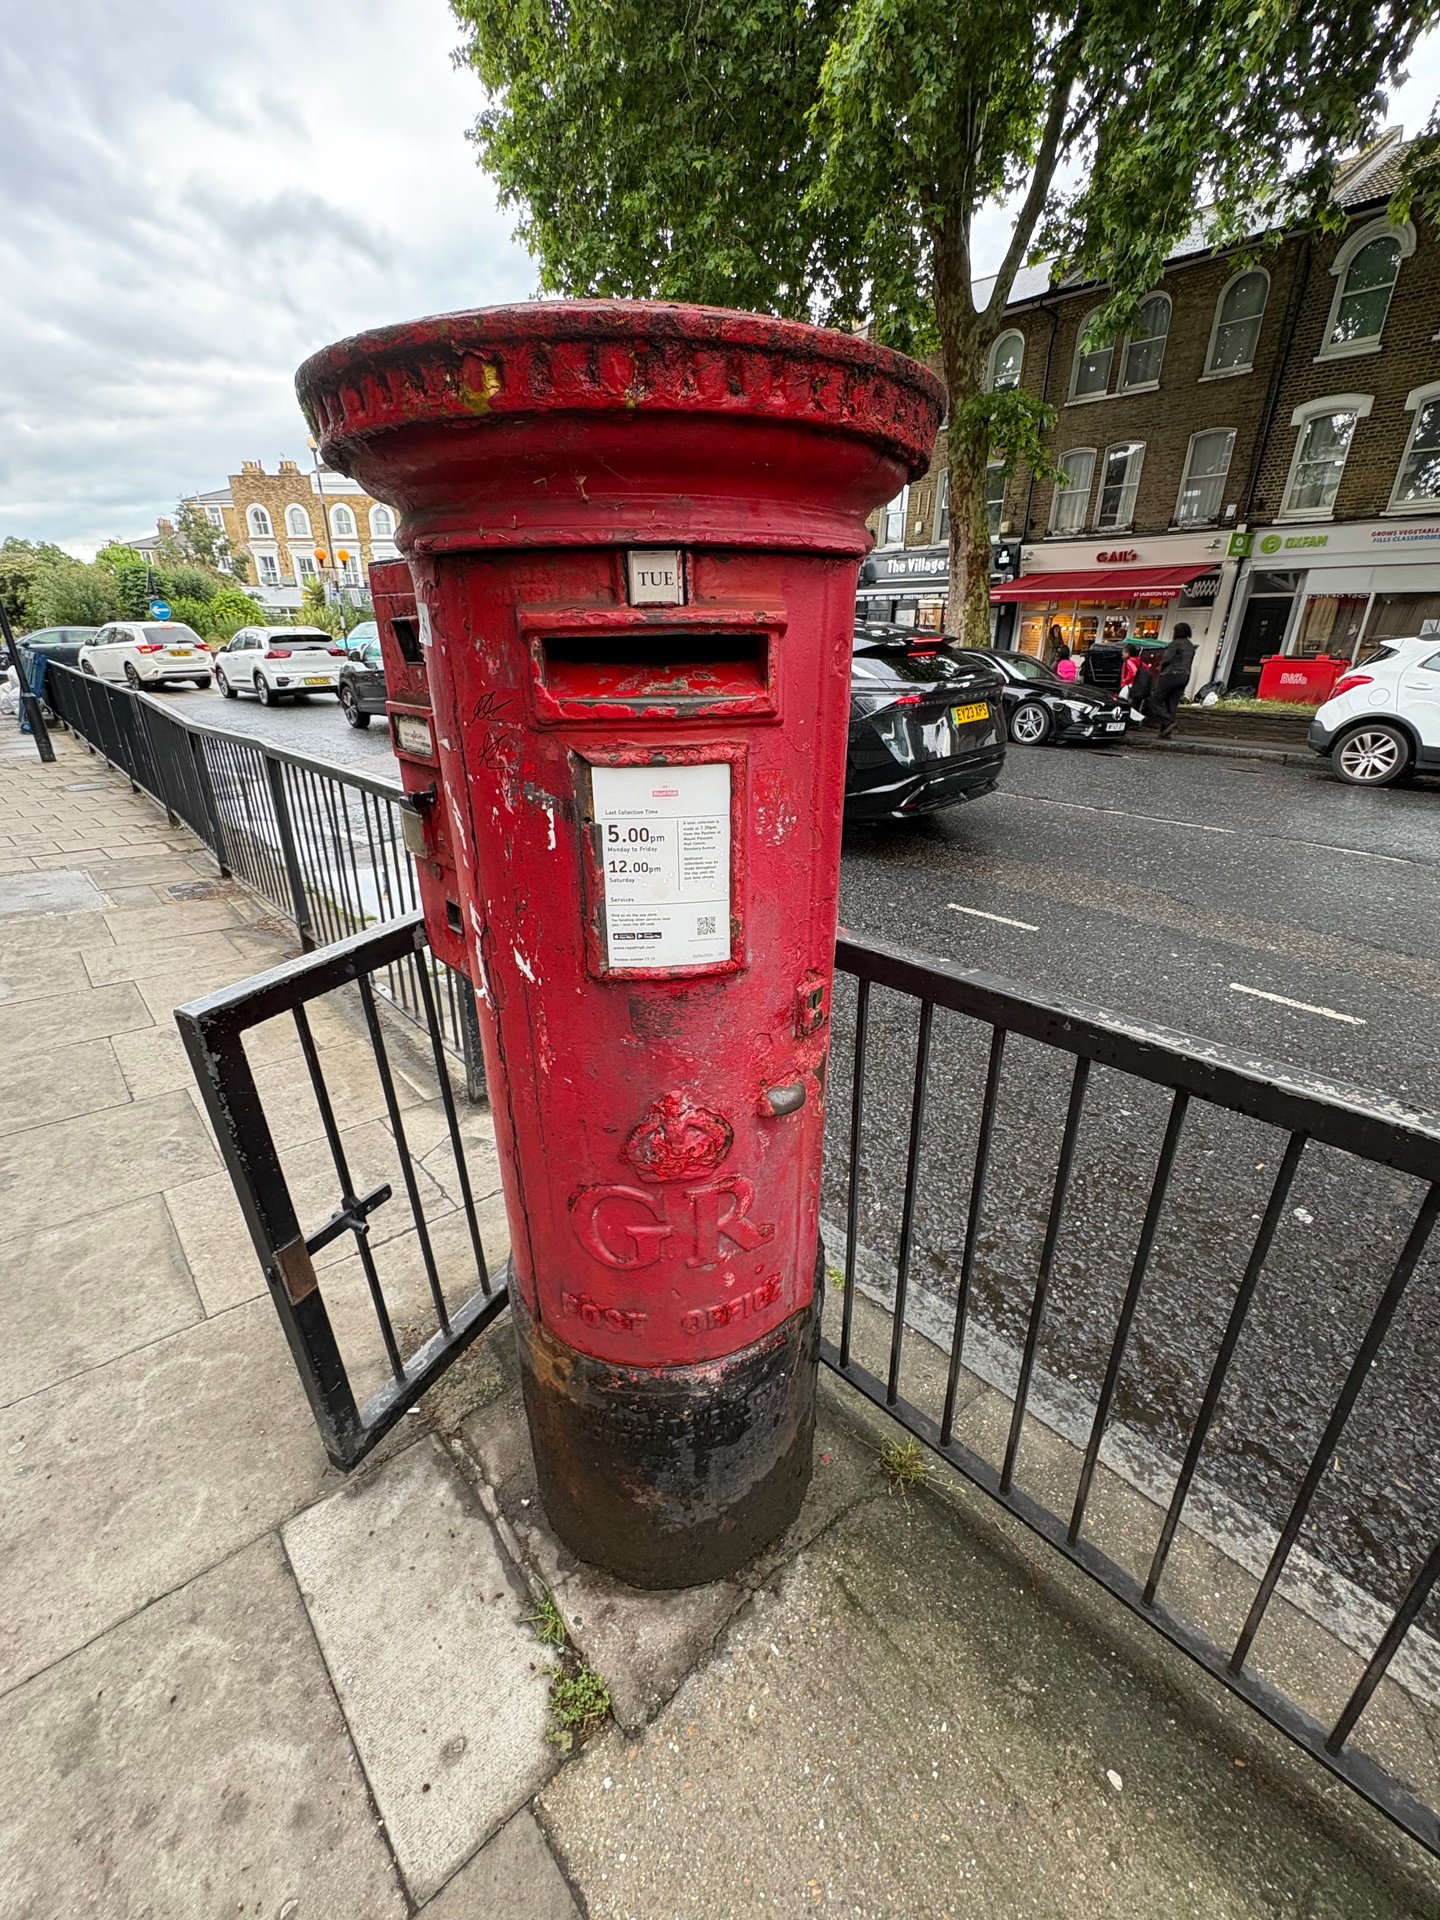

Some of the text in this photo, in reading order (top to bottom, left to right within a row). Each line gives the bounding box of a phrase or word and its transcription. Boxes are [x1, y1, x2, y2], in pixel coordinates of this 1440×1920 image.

[1284, 534, 1328, 548] OXFAM
[888, 560, 906, 574] The
[908, 557, 946, 574] Village
[638, 572, 674, 586] TUE
[957, 704, 987, 720] EY23 XPS
[608, 824, 665, 844] 5.00pm
[608, 860, 661, 874] 12.00pm
